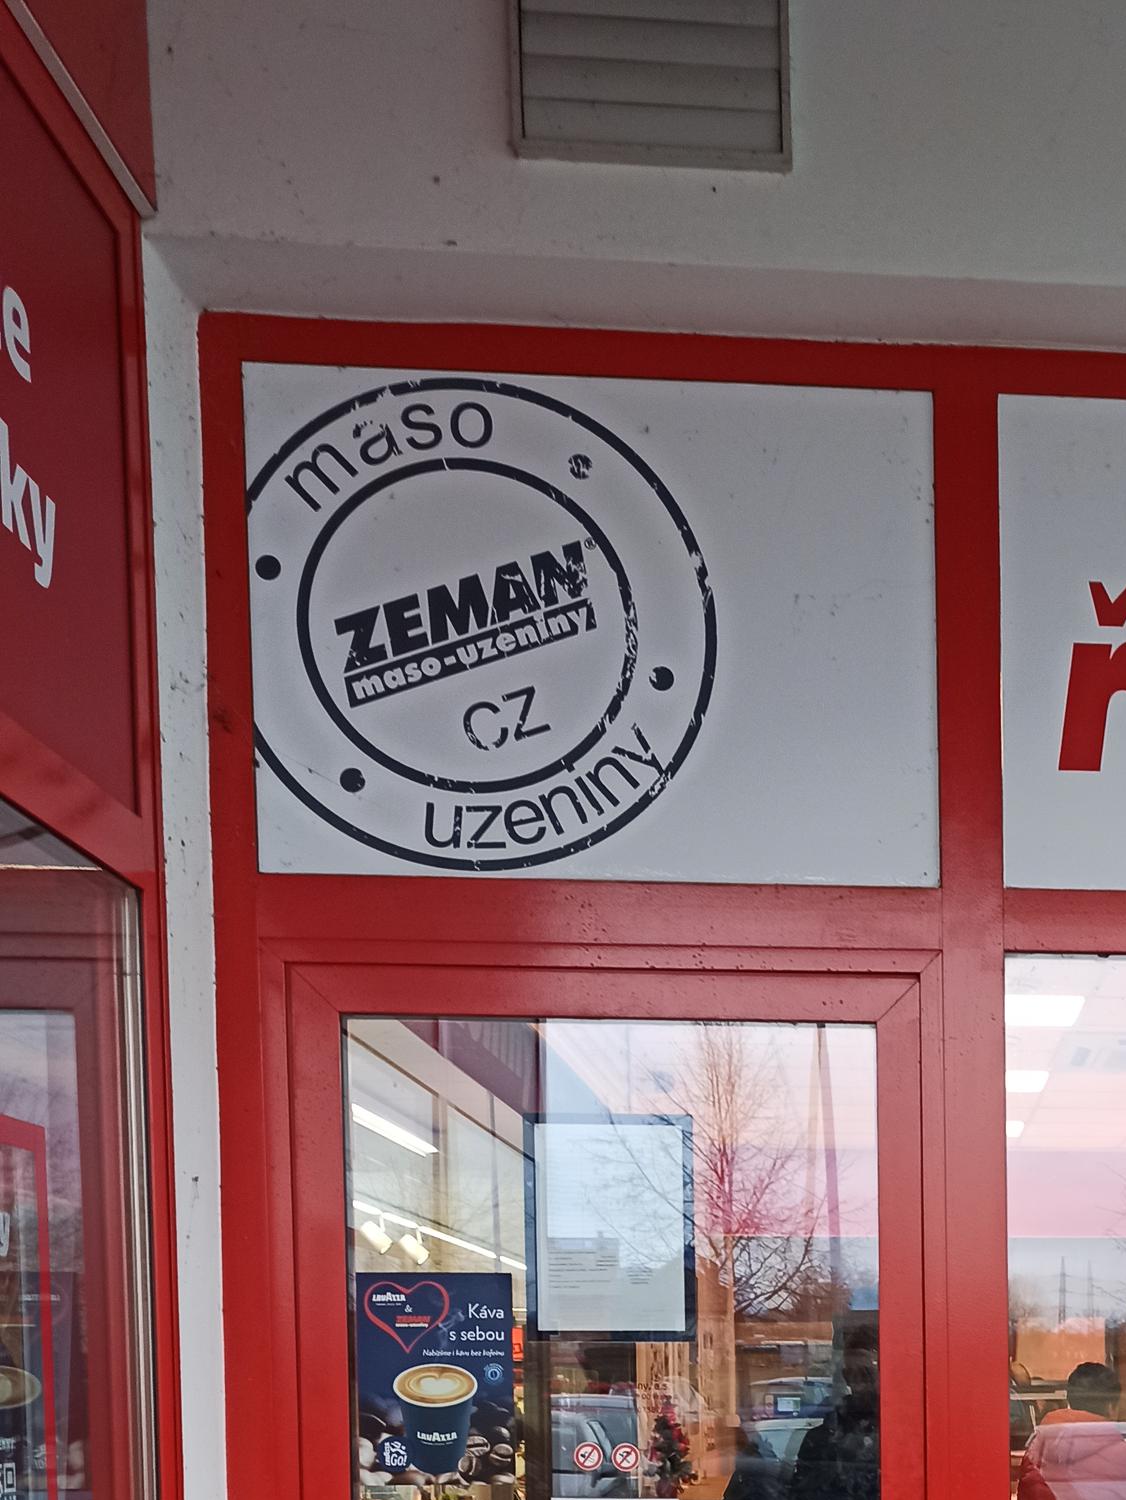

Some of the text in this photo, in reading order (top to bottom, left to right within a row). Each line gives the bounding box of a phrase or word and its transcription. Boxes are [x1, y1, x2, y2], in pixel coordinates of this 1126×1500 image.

[333, 540, 589, 674] ZEMAN
[351, 605, 590, 701] maso-uzeniny
[462, 685, 551, 751] CZ
[424, 722, 668, 849] uzeniny
[449, 1325, 505, 1341] s sebou
[467, 1302, 505, 1319] Káva
